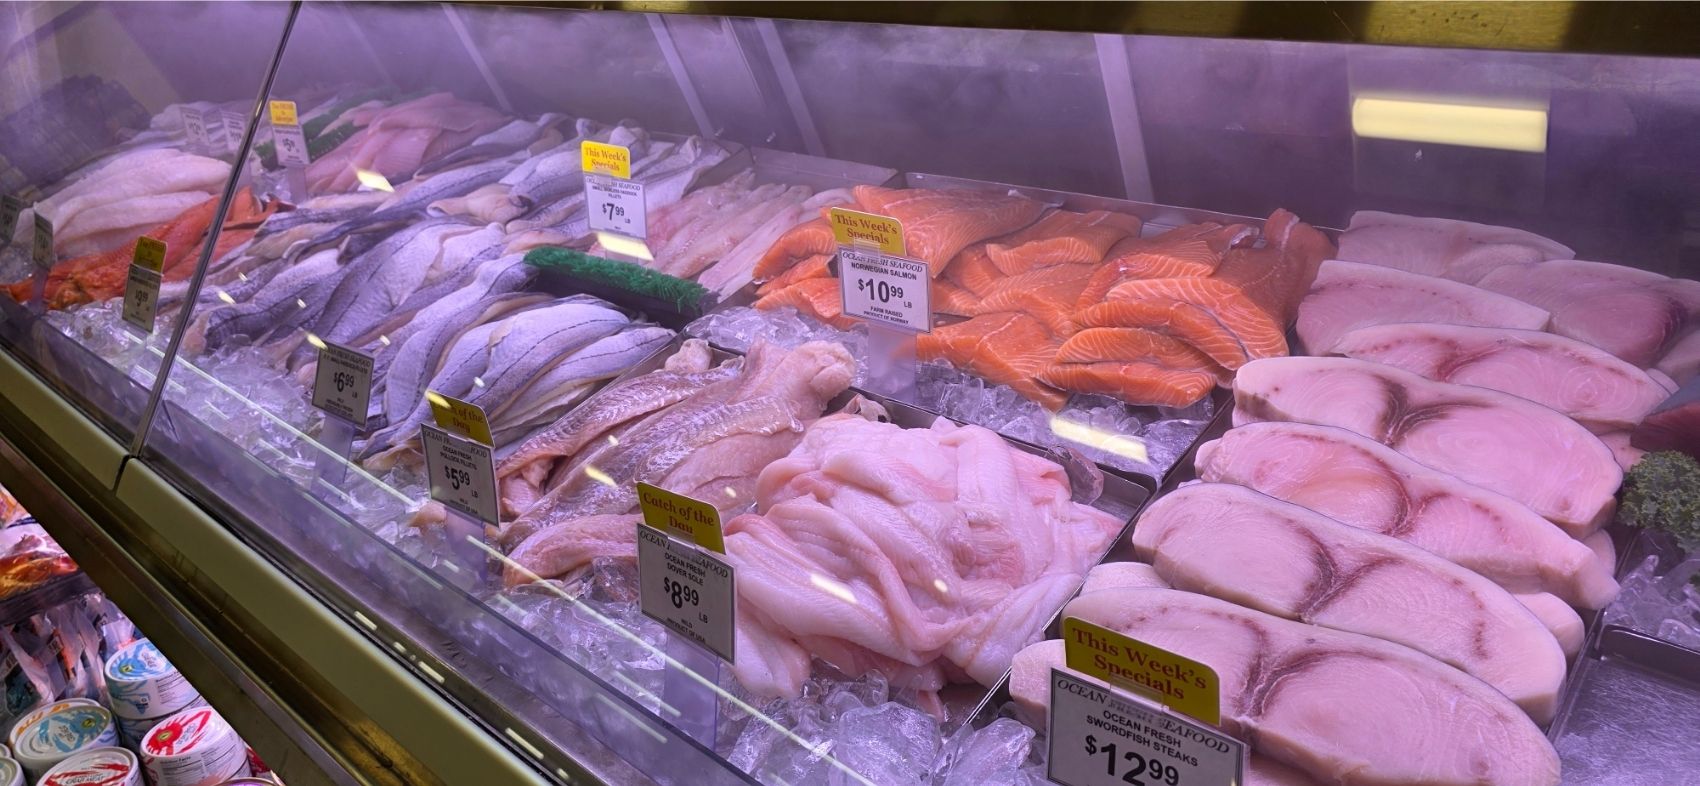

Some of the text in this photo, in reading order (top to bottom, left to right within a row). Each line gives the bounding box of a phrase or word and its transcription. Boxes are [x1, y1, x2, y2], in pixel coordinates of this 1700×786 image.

[584, 147, 627, 162] This Week's
[591, 159, 620, 171] Specials
[835, 214, 897, 235] This Week's
[847, 229, 890, 245] Specials
[851, 262, 917, 280] NORWEGIAN SALMON
[890, 259, 923, 273] SEAFOOD
[903, 301, 912, 309] LB
[863, 310, 883, 319] PRODUCT
[890, 316, 909, 325] NORWAY
[885, 309, 903, 318] RAISED
[460, 407, 484, 423] of the
[442, 445, 472, 461] OCEAN FRESH
[471, 489, 478, 498] LB
[643, 491, 715, 527] Catch of the
[639, 529, 667, 549] OCEAN
[664, 552, 685, 569] OCEAN
[686, 562, 706, 577] FRESH
[667, 562, 704, 586] DOVER SOLE
[680, 617, 693, 628] WILD
[698, 611, 709, 624] LB
[695, 632, 706, 644] USA
[1072, 627, 1207, 690] This Week's
[1094, 654, 1185, 700] Specials
[1057, 678, 1108, 704] OCEAN
[1103, 710, 1181, 748] OCEAN FRESH
[1086, 715, 1198, 767] SWORDFISH STEAKS
